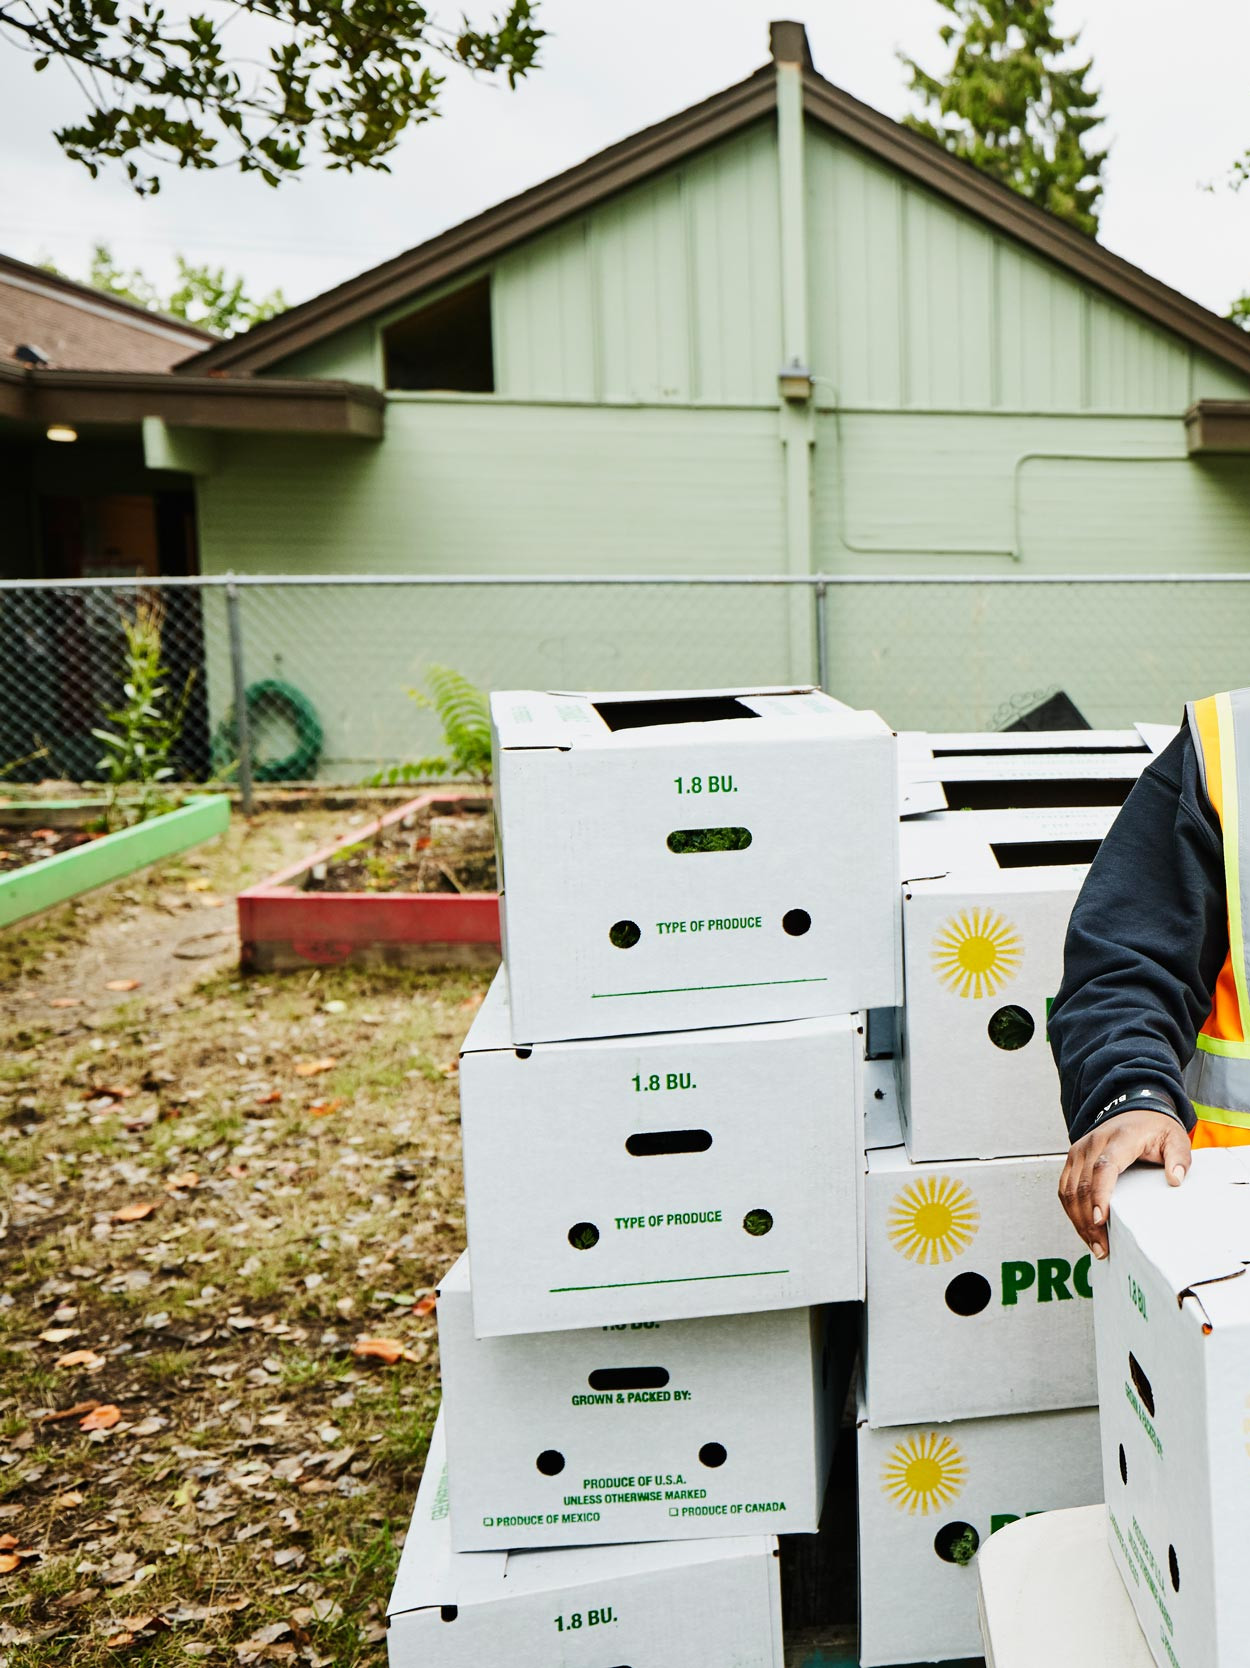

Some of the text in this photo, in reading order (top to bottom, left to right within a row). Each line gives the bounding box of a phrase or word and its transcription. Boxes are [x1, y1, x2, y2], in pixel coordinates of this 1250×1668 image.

[674, 775, 738, 794] 1.8 BU.
[656, 916, 763, 935] TYPE OF PRODUCE
[632, 1073, 697, 1092] 1.8 BU.
[614, 1210, 723, 1230] TYPE OF PRODUCE
[572, 1390, 692, 1406] GROWN & PACKED BY:
[583, 1474, 687, 1490] PRODUCE OF U.S.A.
[563, 1489, 707, 1506] UNLESS OTHERWISE MARKED
[681, 1502, 787, 1517] PRODUCE OF CANADA
[496, 1512, 601, 1527] PRODUCE OF MEXICO
[554, 1606, 618, 1633] 1.8 BU.
